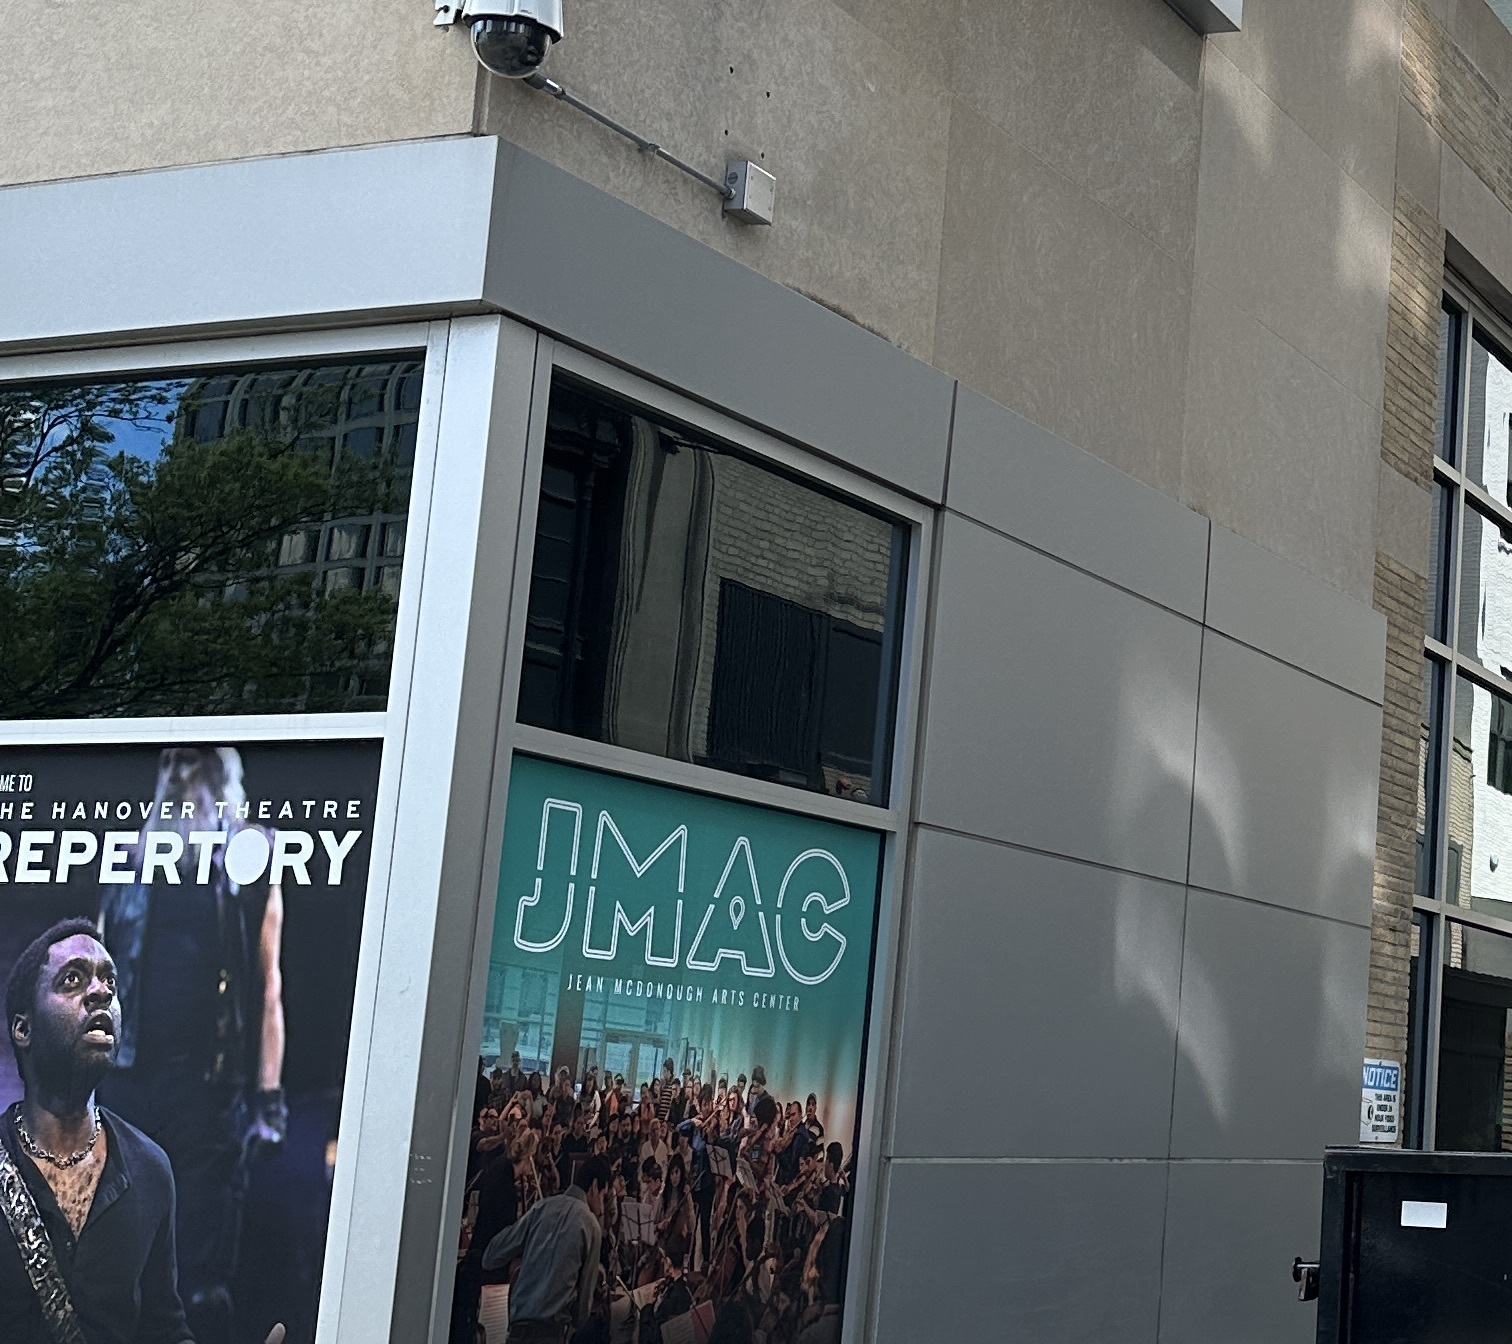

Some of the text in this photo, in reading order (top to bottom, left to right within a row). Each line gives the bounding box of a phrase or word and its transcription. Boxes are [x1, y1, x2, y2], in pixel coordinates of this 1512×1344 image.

[18, 774, 33, 792] TO
[51, 801, 195, 820] HANOVER
[215, 800, 362, 819] THEATRE
[0, 829, 362, 886] EPERTORY
[514, 798, 851, 985] JMAC
[567, 974, 800, 1011] JEAN MCDONOUGH ARTS CENTER
[1363, 1066, 1398, 1089] NOTICE
